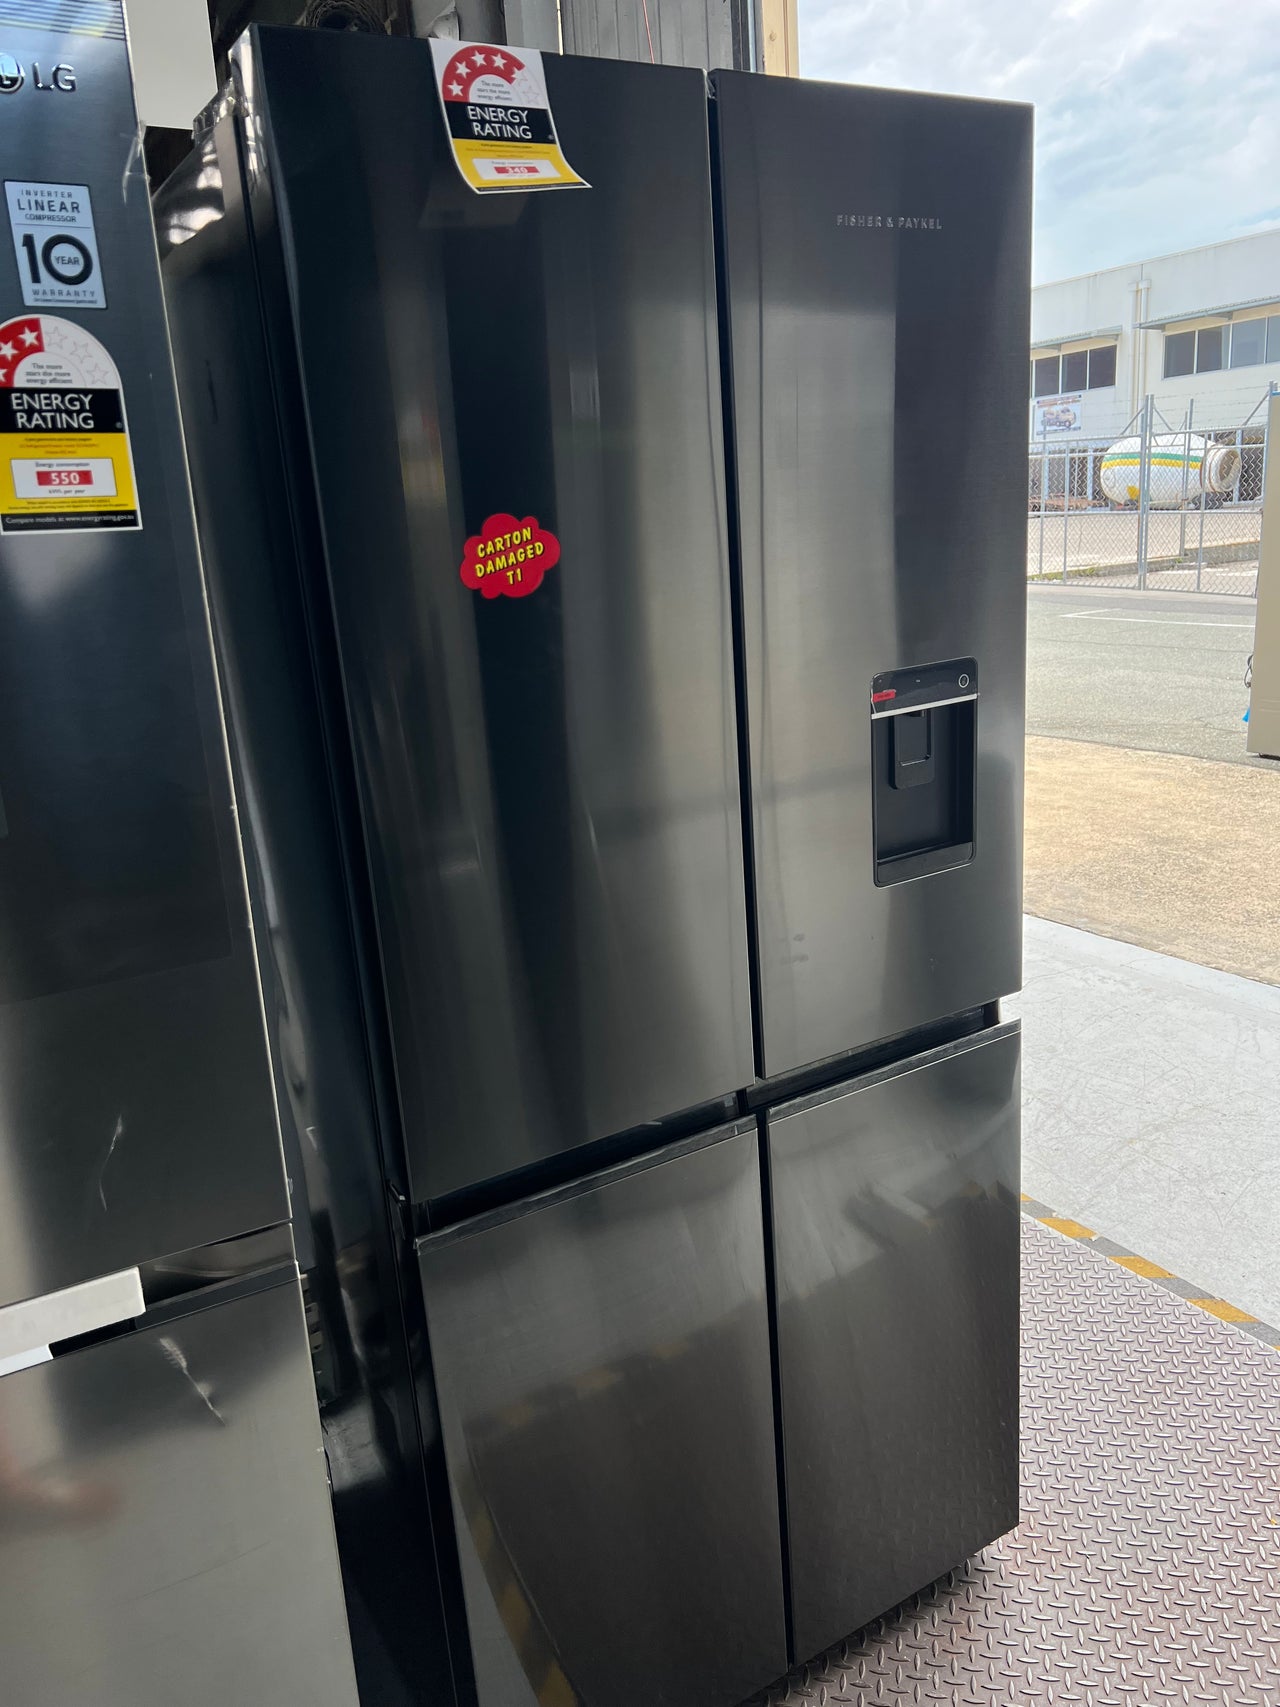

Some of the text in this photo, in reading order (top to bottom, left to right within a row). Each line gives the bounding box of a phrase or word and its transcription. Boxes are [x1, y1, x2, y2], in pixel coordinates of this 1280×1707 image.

[32, 62, 77, 92] LG
[467, 105, 528, 124] ENERGY
[472, 122, 533, 139] RATING
[21, 189, 73, 199] INVERTER
[17, 198, 81, 213] LINEAR
[25, 213, 77, 223] COMPRESSOR
[836, 214, 943, 230] FISHER & PAYKEL
[22, 233, 93, 286] 10
[54, 256, 80, 266] YEAR
[32, 288, 95, 298] WARRANTY
[11, 393, 93, 410] ENERGY
[16, 412, 95, 429] RATING
[51, 472, 80, 485] 550
[478, 526, 532, 558] CARTON
[475, 541, 544, 578] DAMAGED
[506, 567, 522, 585] T1
